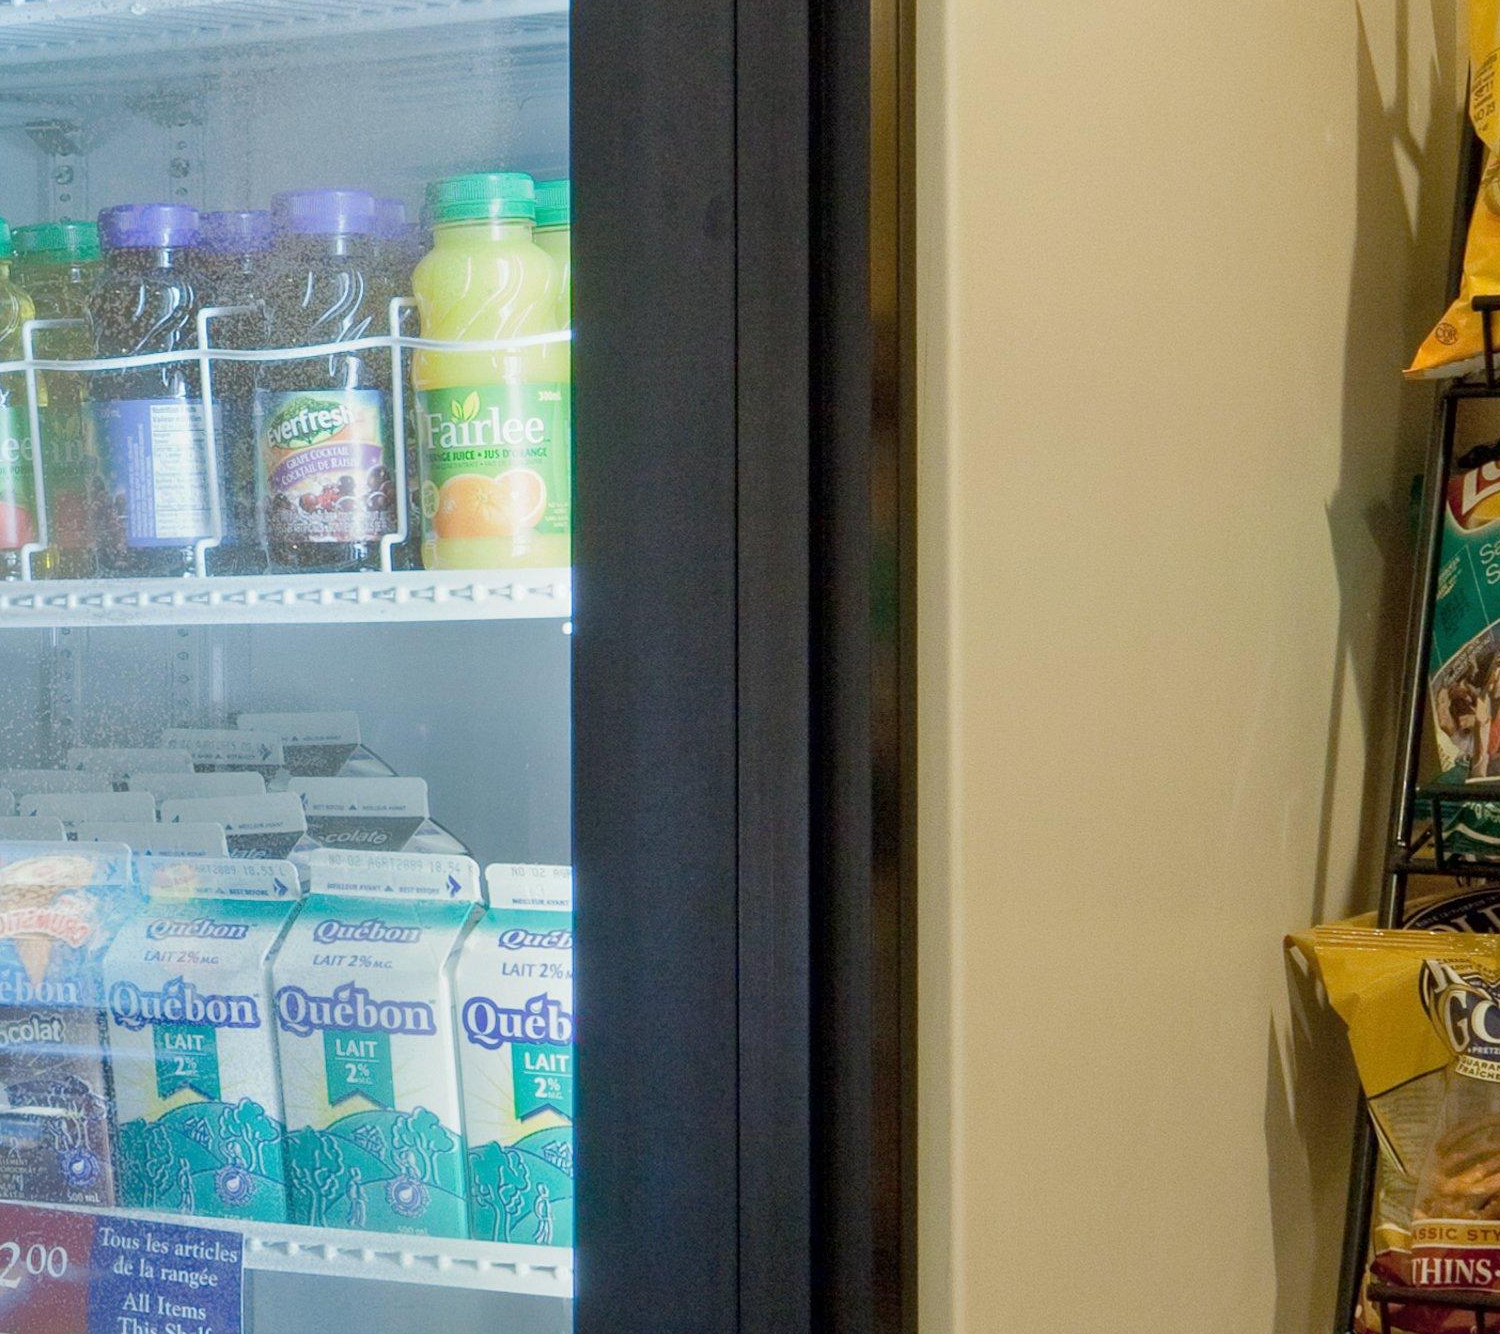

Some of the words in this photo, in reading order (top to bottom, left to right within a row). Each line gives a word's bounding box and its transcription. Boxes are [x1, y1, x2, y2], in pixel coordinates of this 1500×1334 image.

[426, 412, 545, 449] Fairlee
[313, 920, 421, 943] Québon
[313, 955, 346, 967] LAIT
[112, 983, 258, 1033] Québon
[280, 990, 434, 1034] Québon
[165, 1032, 202, 1052] LAIT
[335, 1038, 378, 1058] LAIT
[346, 1062, 371, 1083] 2%
[524, 1052, 570, 1072] LAIT
[535, 1075, 562, 1098] 2%
[100, 1227, 141, 1252] Tous
[147, 1232, 169, 1253] les
[174, 1236, 239, 1264] articles
[113, 1255, 132, 1275] de
[137, 1258, 153, 1277] la
[158, 1263, 218, 1290] rangée
[123, 1292, 151, 1313] All
[157, 1295, 207, 1320] Items
